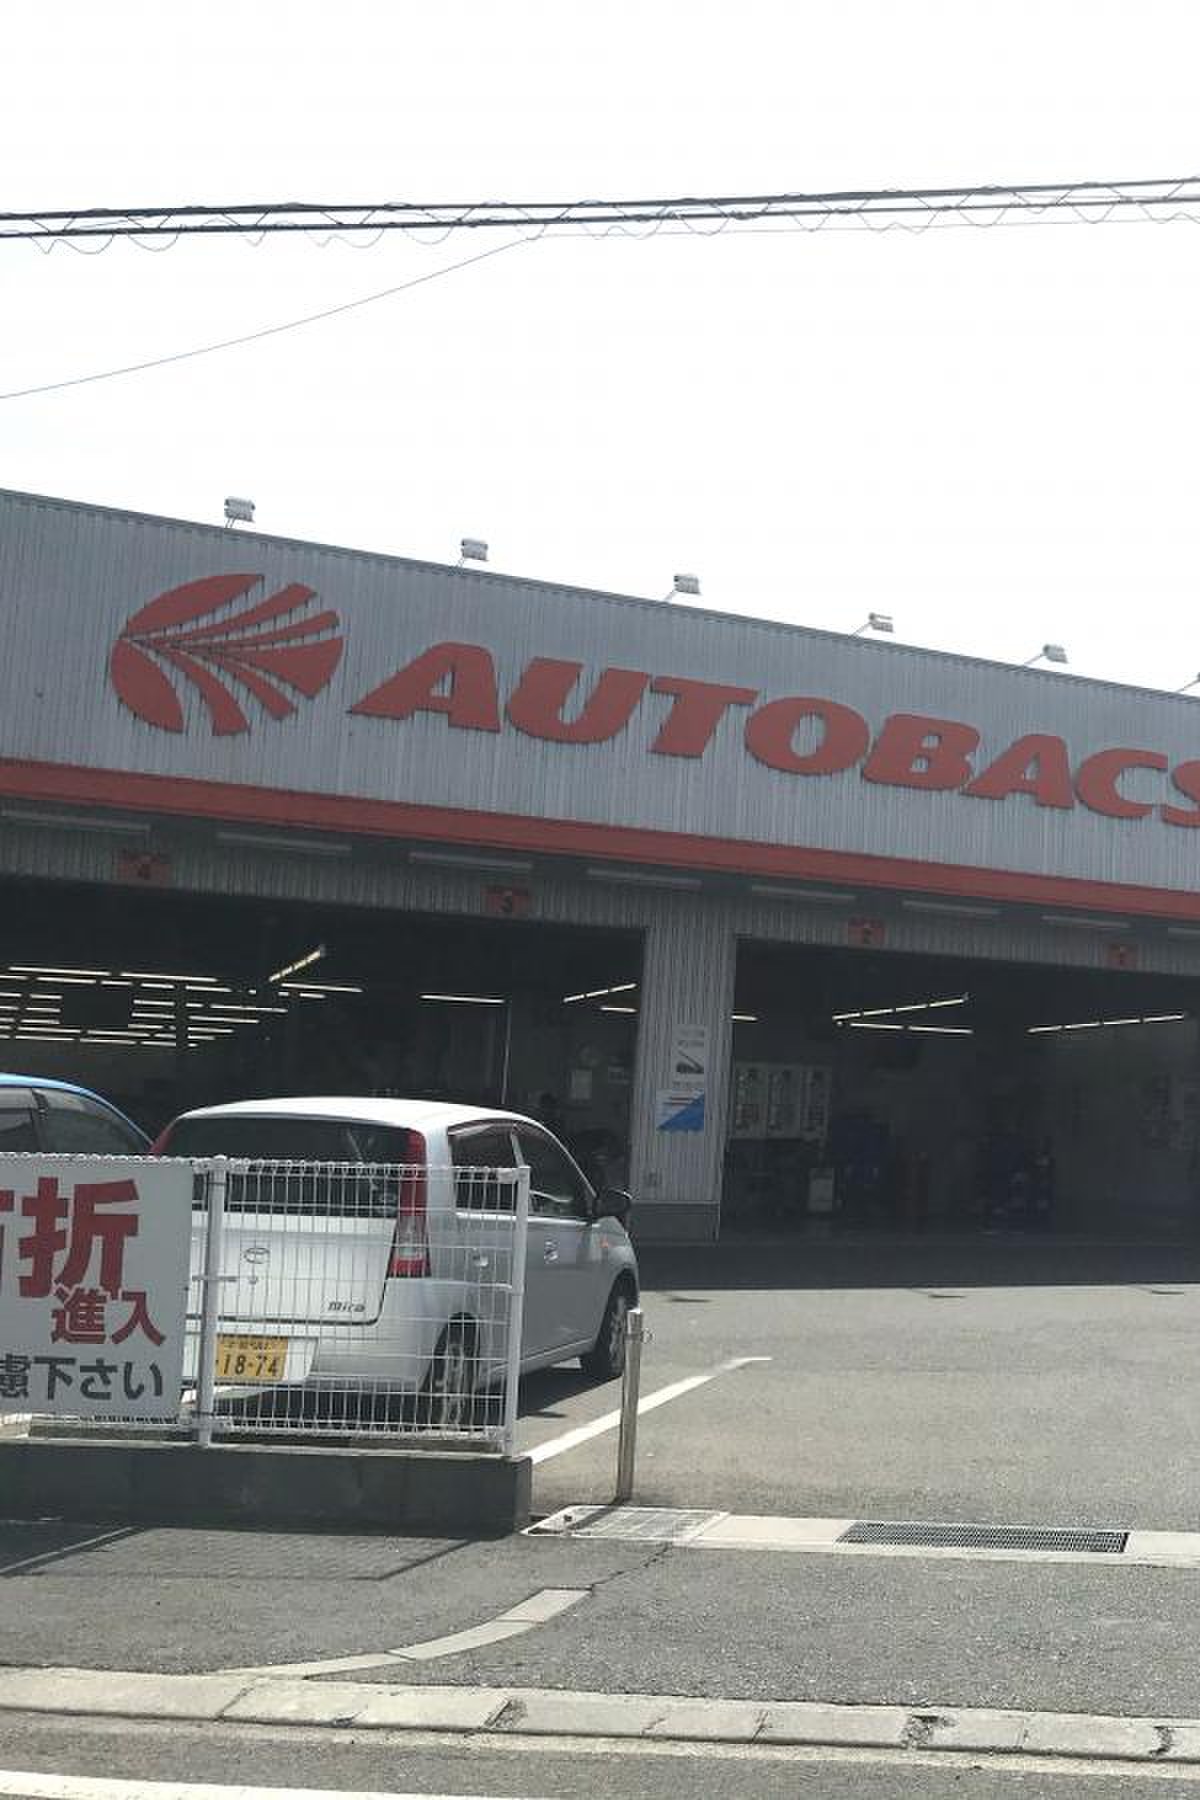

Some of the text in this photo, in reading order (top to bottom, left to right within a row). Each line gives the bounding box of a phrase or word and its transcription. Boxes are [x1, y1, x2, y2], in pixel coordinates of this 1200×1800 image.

[0, 1177, 140, 1299] 折
[51, 1287, 166, 1346] 進入
[0, 1353, 163, 1400] 慮下さい
